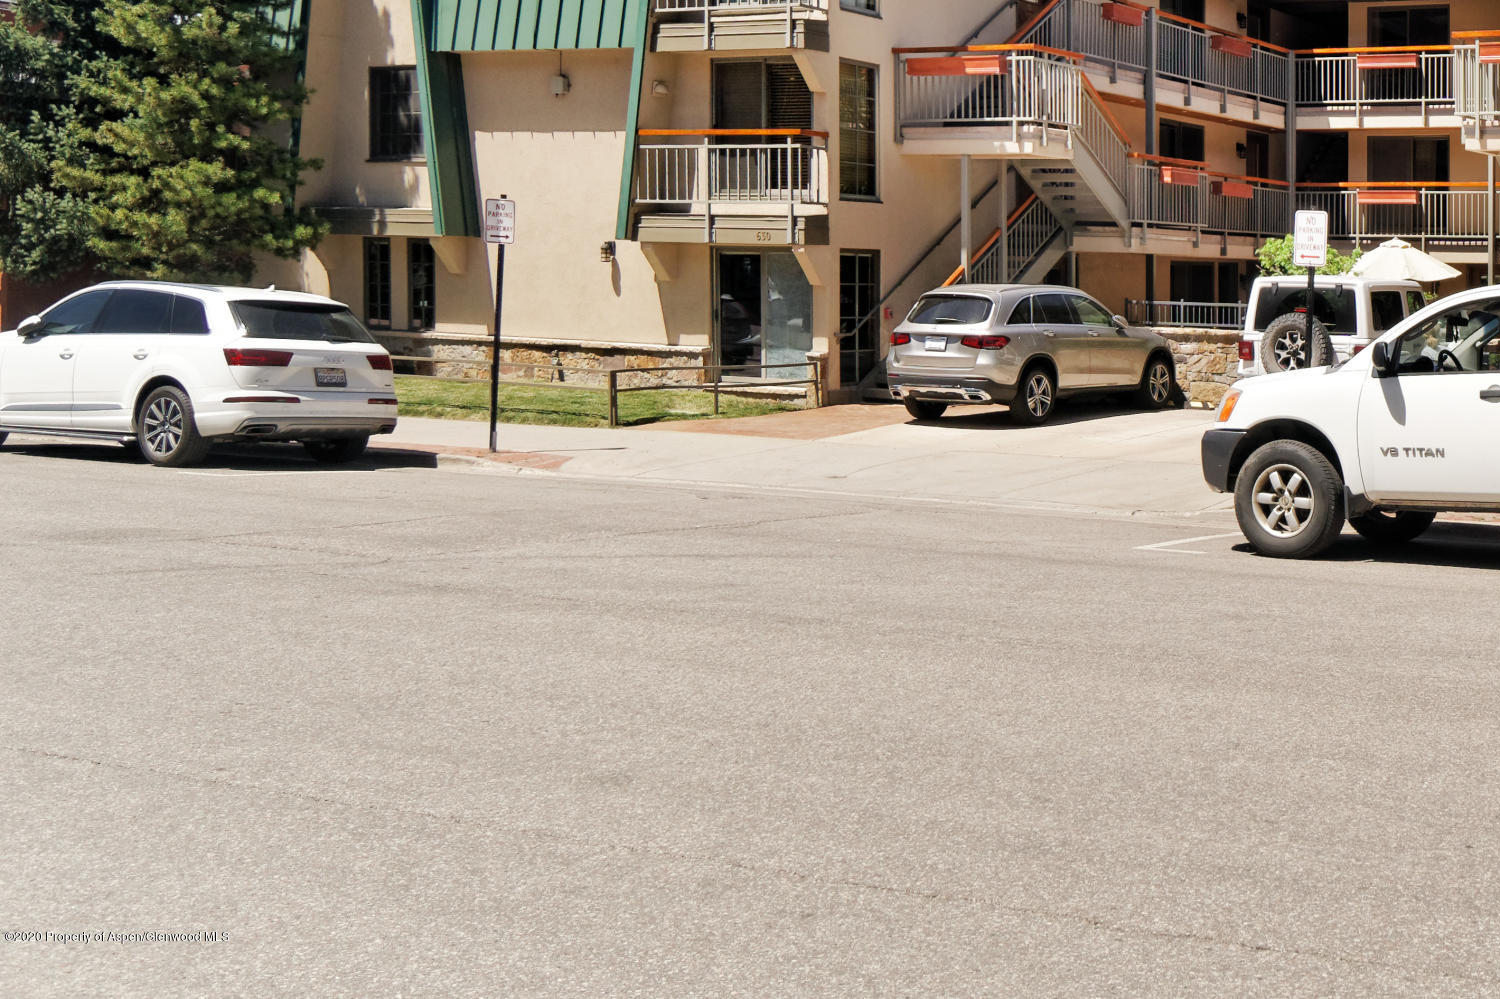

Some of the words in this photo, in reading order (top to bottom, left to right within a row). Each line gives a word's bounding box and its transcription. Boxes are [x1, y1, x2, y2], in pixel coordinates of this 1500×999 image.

[495, 203, 506, 211] NO
[1305, 216, 1317, 226] NO
[1379, 446, 1399, 458] V8
[1402, 447, 1446, 459] TITAN
